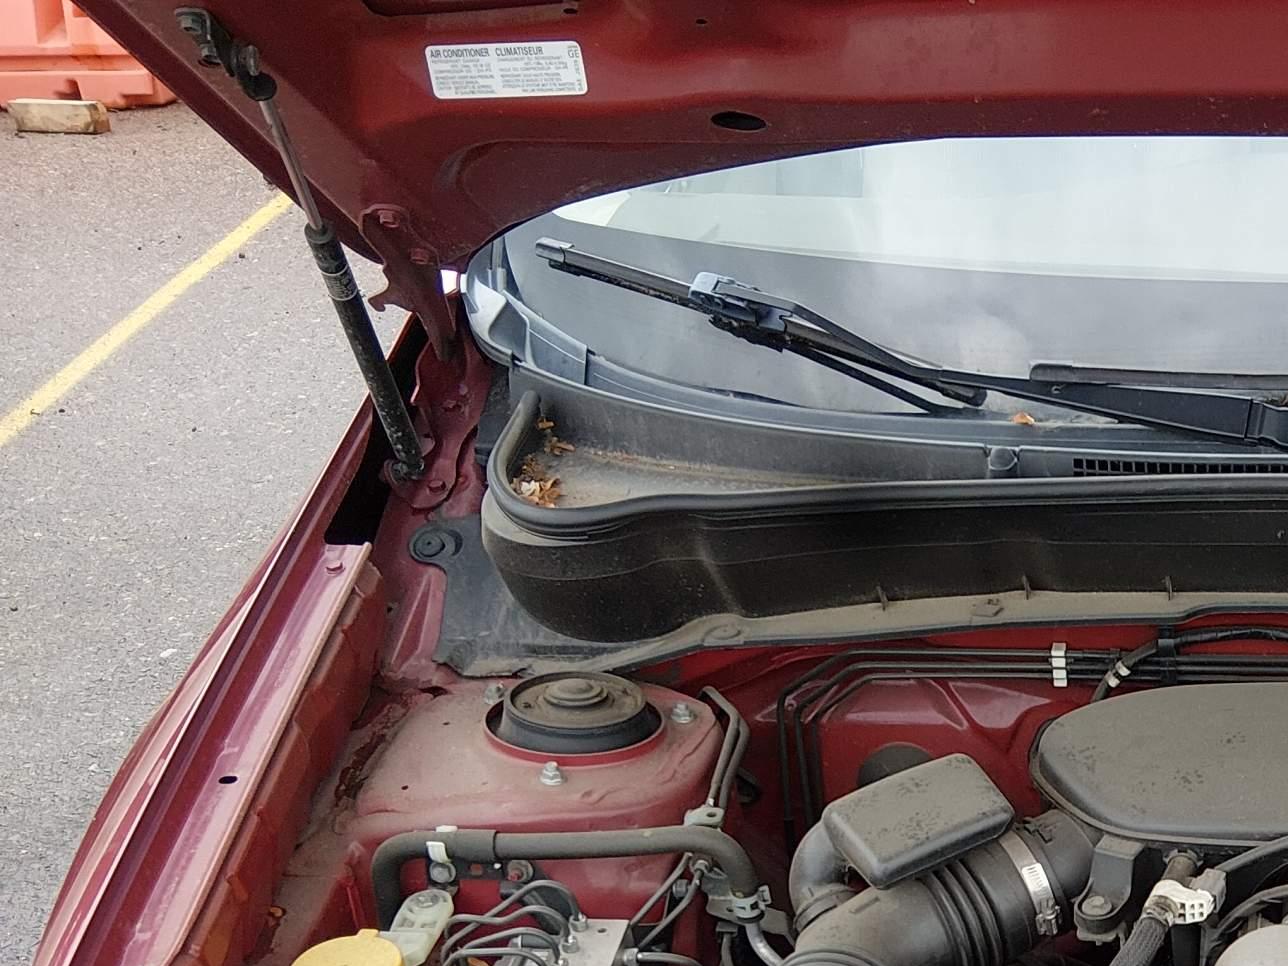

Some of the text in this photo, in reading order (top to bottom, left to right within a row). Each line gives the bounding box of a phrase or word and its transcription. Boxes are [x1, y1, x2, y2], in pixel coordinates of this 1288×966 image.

[430, 48, 490, 58] AIR CONDITIONER
[495, 46, 544, 57] CLIMATISEUR
